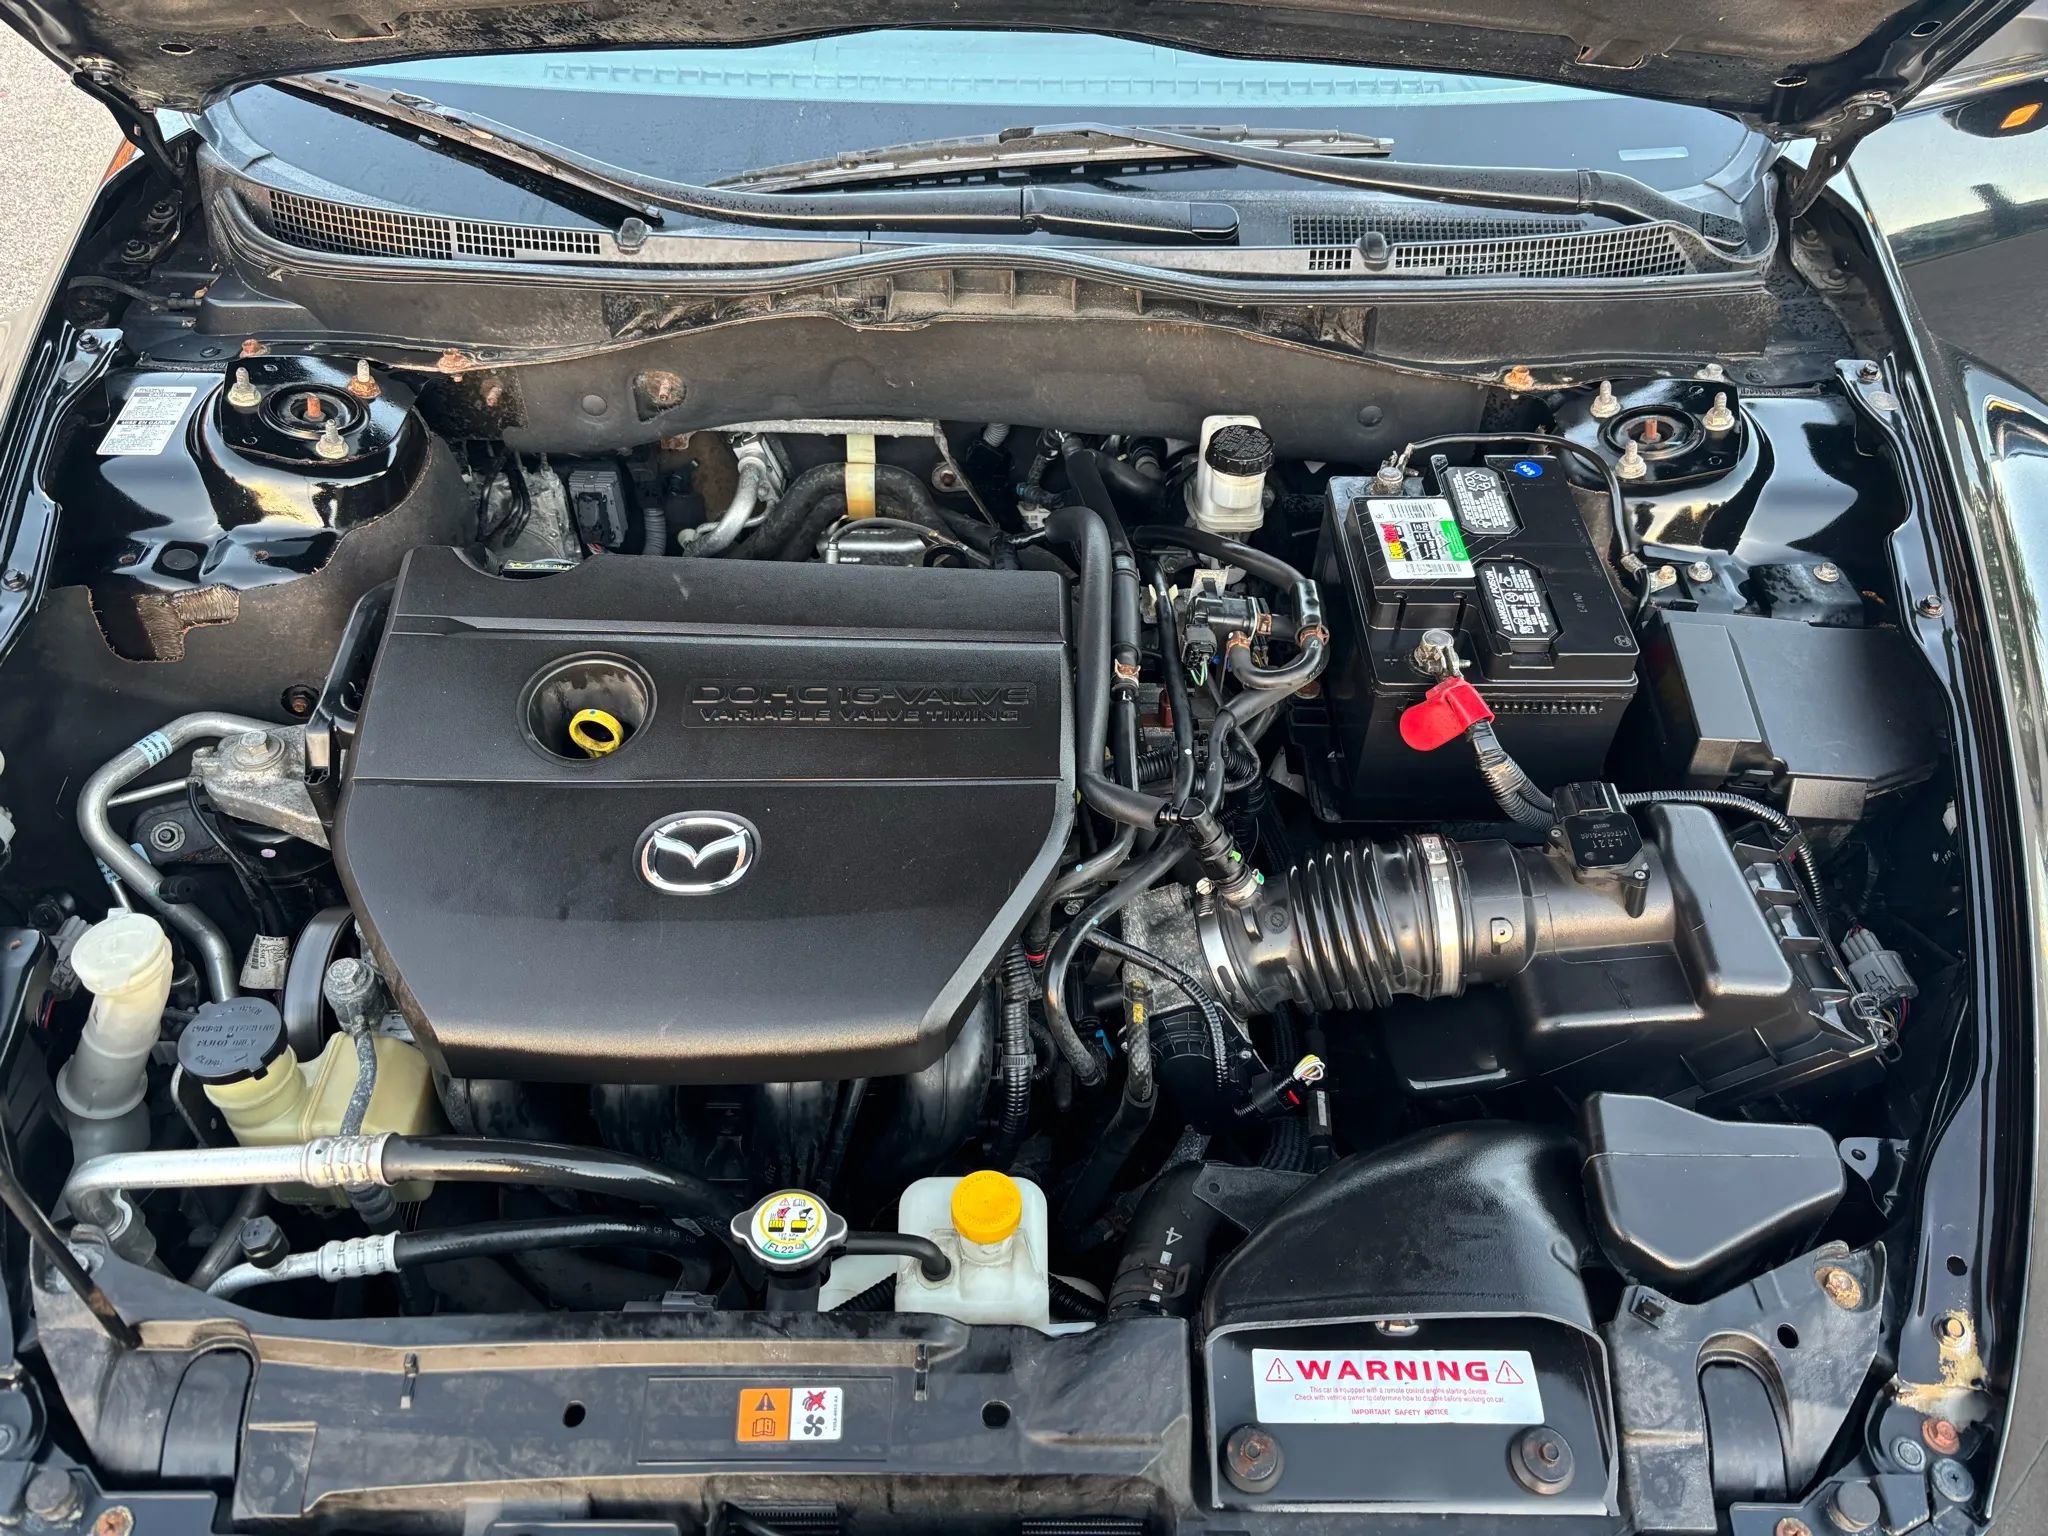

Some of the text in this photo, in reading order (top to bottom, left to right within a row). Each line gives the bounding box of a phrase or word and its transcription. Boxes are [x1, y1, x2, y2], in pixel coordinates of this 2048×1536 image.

[1484, 570, 1500, 594] POISON
[692, 685, 1030, 706] DOHC 16-VALVE
[699, 708, 1019, 722] VARIABLE VALVE TIMING
[767, 1242, 794, 1254] FL22
[1296, 1360, 1489, 1381] WARNING
[1426, 1388, 1444, 1396] engine
[1445, 1387, 1467, 1396] starting
[1295, 1393, 1313, 1401] Check
[1401, 1394, 1414, 1402] how
[1443, 1395, 1462, 1403] before
[1463, 1396, 1486, 1404] working
[1351, 1408, 1391, 1416] IMPORTANT
[1394, 1408, 1421, 1416] SAFETY
